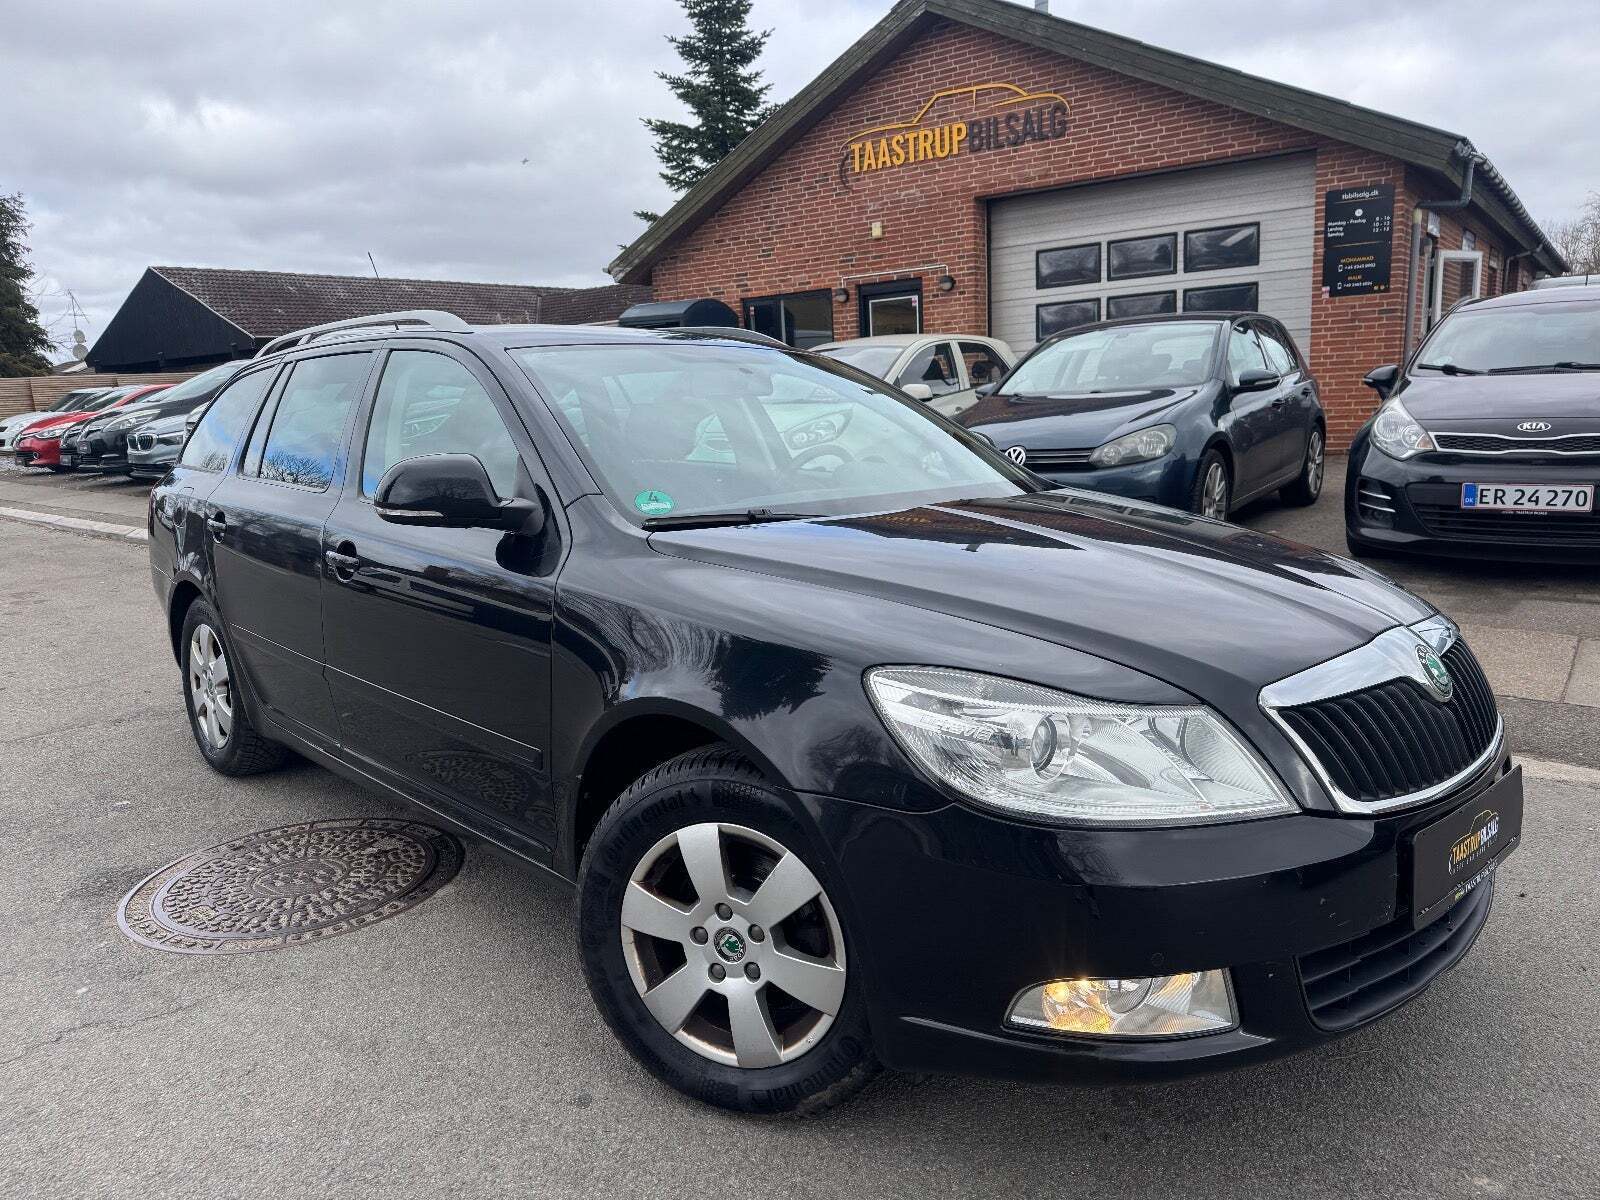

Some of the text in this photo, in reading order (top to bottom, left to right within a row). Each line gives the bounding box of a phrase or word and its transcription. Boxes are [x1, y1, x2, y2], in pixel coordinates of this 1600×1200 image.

[1522, 422, 1546, 430] KIA
[648, 491, 659, 503] 4
[1479, 488, 1588, 507] ER 24 270
